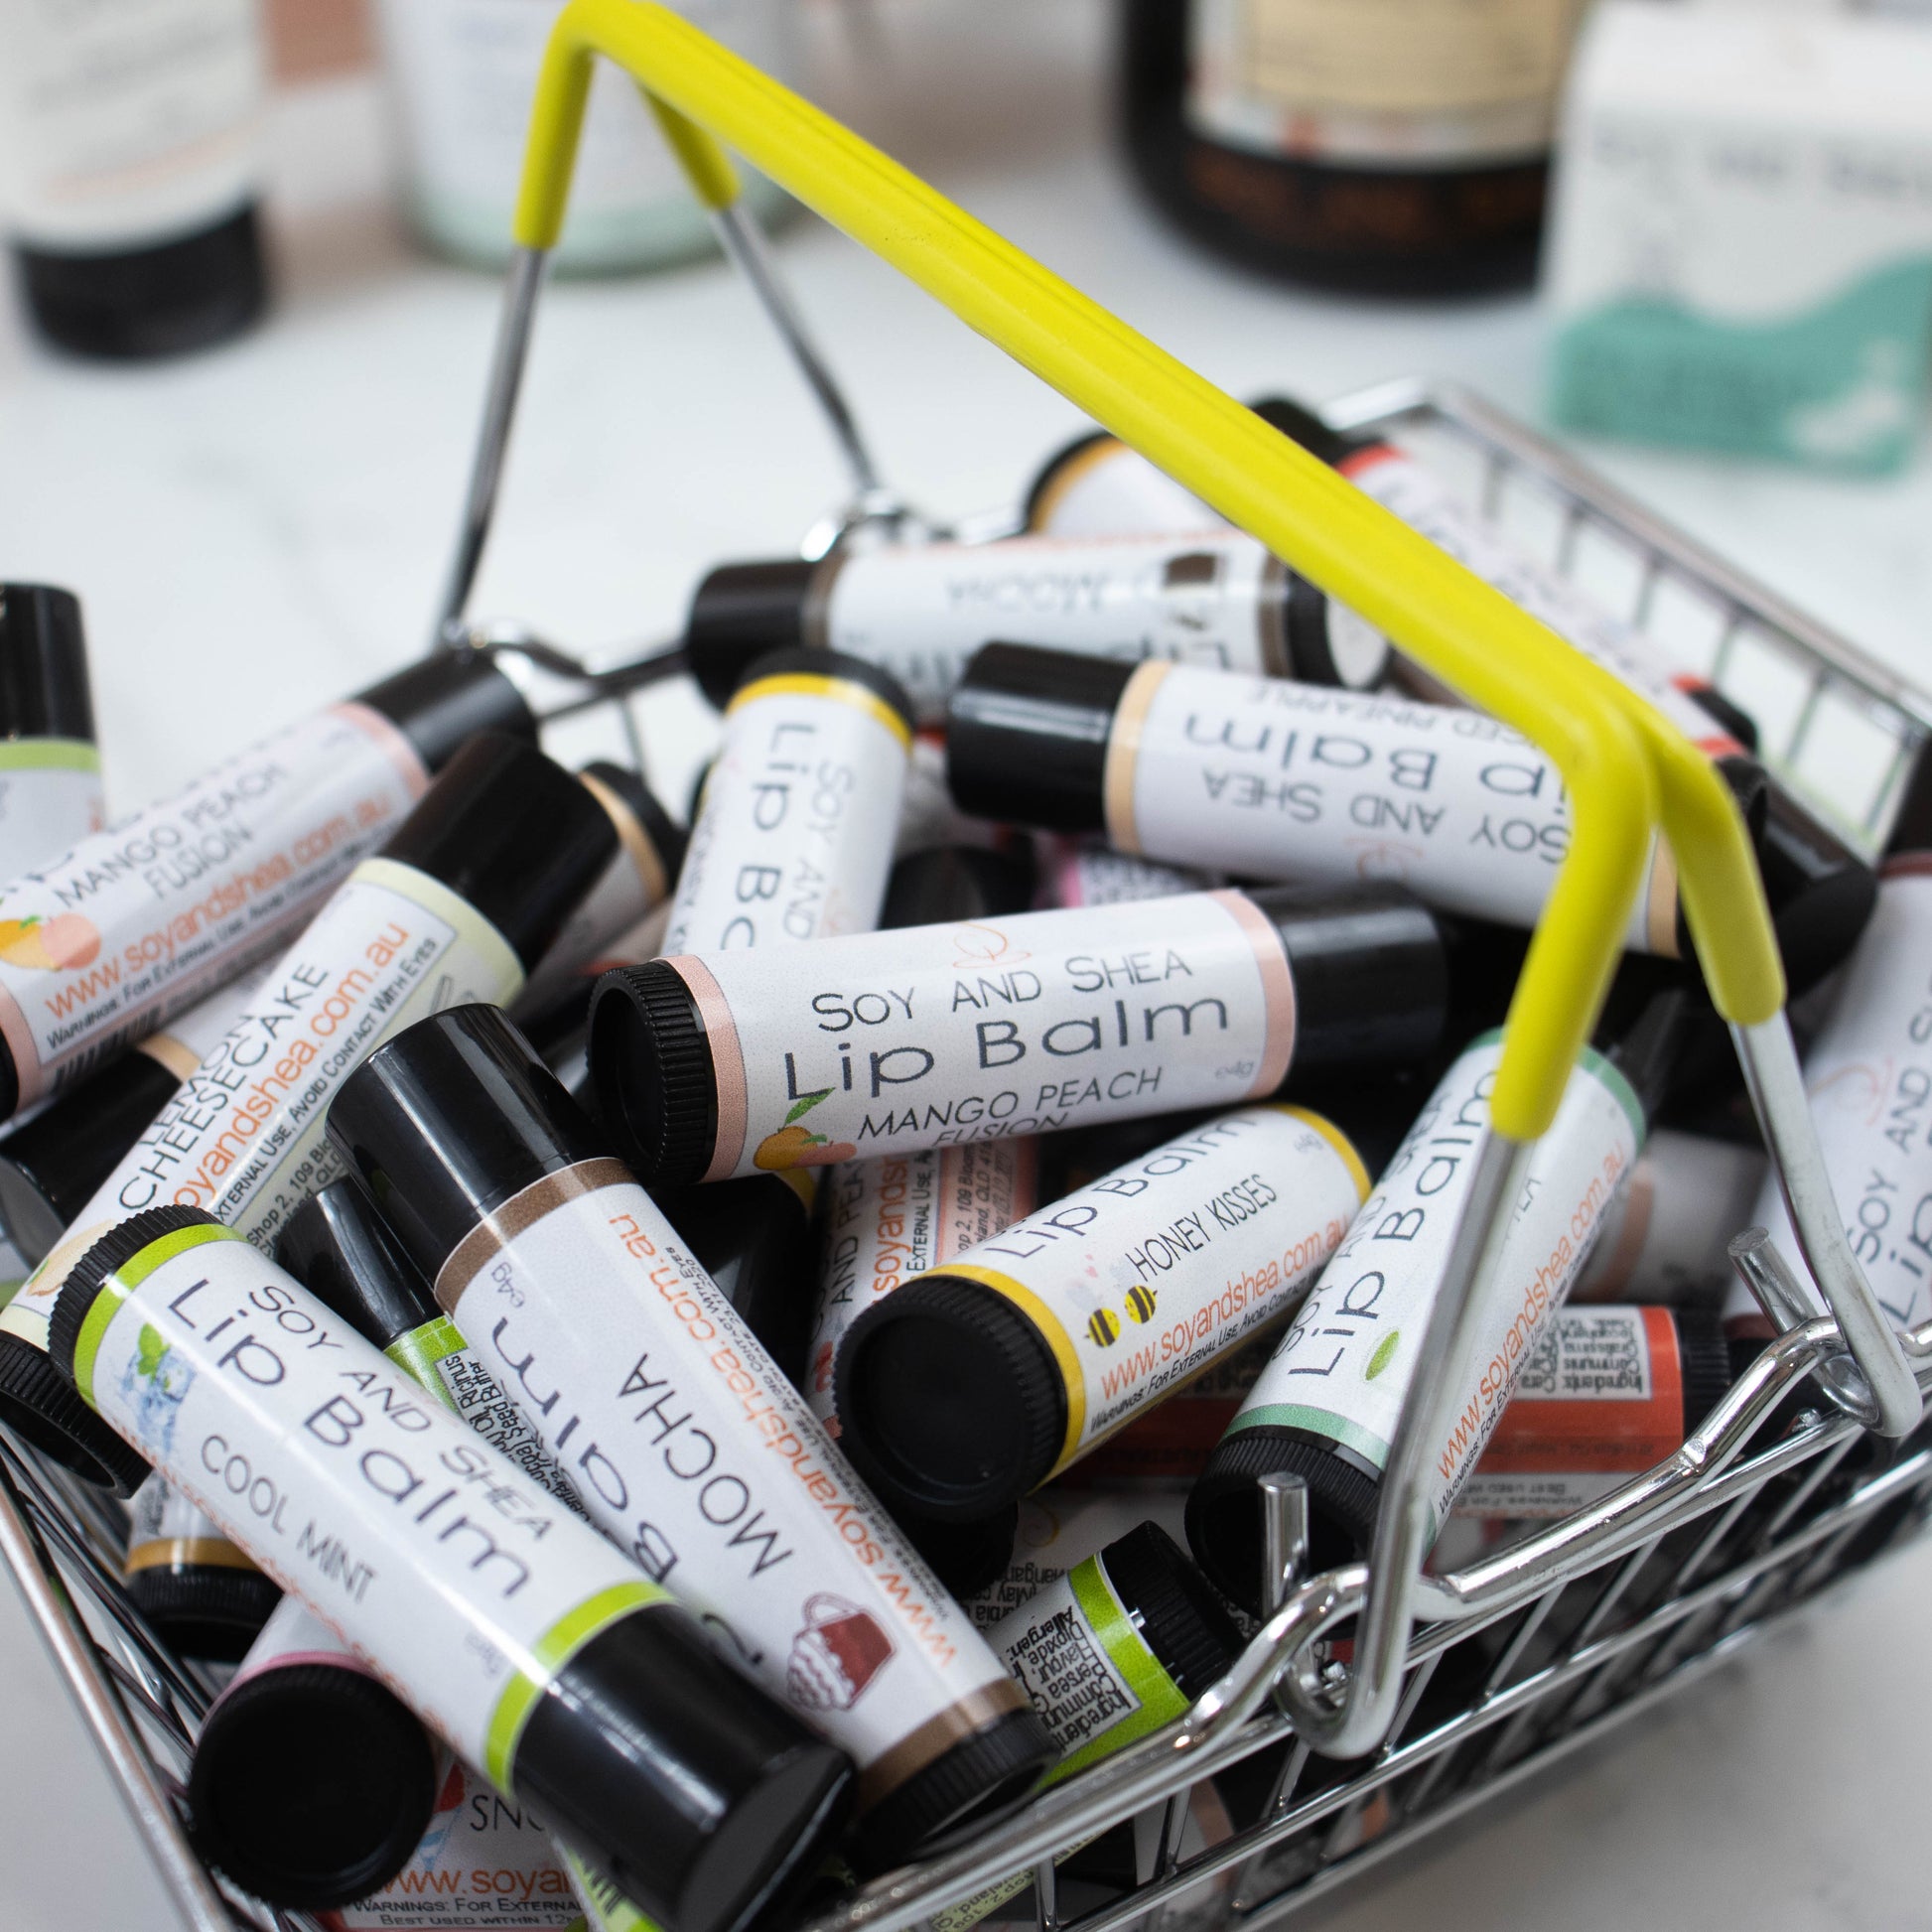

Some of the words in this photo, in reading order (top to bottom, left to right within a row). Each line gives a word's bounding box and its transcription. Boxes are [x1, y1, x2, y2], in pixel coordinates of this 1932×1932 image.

[752, 722, 818, 832] Lip
[1183, 712, 1439, 791] Balm
[54, 825, 182, 908] MANGO
[182, 762, 288, 825] PEACH
[1201, 767, 1322, 824] SHEA
[1349, 791, 1446, 837] AND
[1470, 812, 1572, 865] SOY
[143, 820, 252, 899] FUSION
[782, 856, 826, 941] AND
[45, 795, 393, 1020] www.soyandshea.com.au
[288, 1077, 329, 1125] AVOID
[323, 1013, 377, 1078] CONTACT
[369, 976, 406, 1015] WITH
[399, 937, 438, 979] EYES
[811, 986, 914, 1032] SOY
[952, 970, 1041, 1013] AND
[1064, 949, 1193, 993] SHEA
[118, 963, 330, 1209] CHEESECAKE
[137, 1015, 254, 1147] LEMON
[173, 921, 410, 1206] oyandshea.com.au
[784, 1042, 935, 1101] Lip
[975, 998, 1227, 1069] Balm
[857, 1091, 1020, 1141] MANGO
[1035, 1065, 1162, 1112] PEACH
[932, 1111, 1069, 1147] FUSION
[1884, 1065, 1931, 1155] AND
[246, 1209, 280, 1246] Shop
[289, 1161, 314, 1189] 109
[838, 1159, 866, 1228] PEA
[984, 1205, 1098, 1259] Lip
[1091, 1114, 1258, 1197] Balm
[1124, 1211, 1210, 1282] HONEY
[1204, 1173, 1278, 1232] KISSES
[831, 1235, 860, 1306] AND
[905, 1203, 930, 1272] EXTERNAL
[954, 1232, 973, 1256] op
[1100, 1213, 1349, 1401] www.soyandshea.com.au
[1272, 1284, 1333, 1361] SOY
[1287, 1270, 1385, 1376] Lip
[1438, 1142, 1626, 1479] www.soyandshea.com.au
[1147, 1368, 1170, 1395] FOR
[1169, 1339, 1216, 1380] EXTERNAL
[1480, 1408, 1497, 1439] FOR
[1496, 1348, 1531, 1410] EXTERNAL
[168, 1278, 288, 1386] Lip
[304, 1393, 534, 1599] Balm
[246, 1285, 344, 1350] SOY
[341, 1366, 432, 1433] AND
[439, 1445, 553, 1540] SHEA
[489, 1316, 680, 1585] Balm
[608, 1211, 960, 1670] www.soyandshea.com.au
[617, 1352, 794, 1579] MOCHA
[200, 1435, 288, 1536] COOL
[296, 1519, 378, 1603] MINT
[1032, 1641, 1097, 1684] Flavour,
[1040, 1674, 1118, 1730] Communi
[1047, 1651, 1108, 1699] Persea
[353, 1897, 450, 1913] WARNINGS:
[456, 1897, 492, 1913] FOR
[497, 1897, 583, 1913] EXTERNAL
[380, 1913, 424, 1926] BEST
[429, 1914, 476, 1926] USED
[481, 1914, 539, 1926] WITHIN
